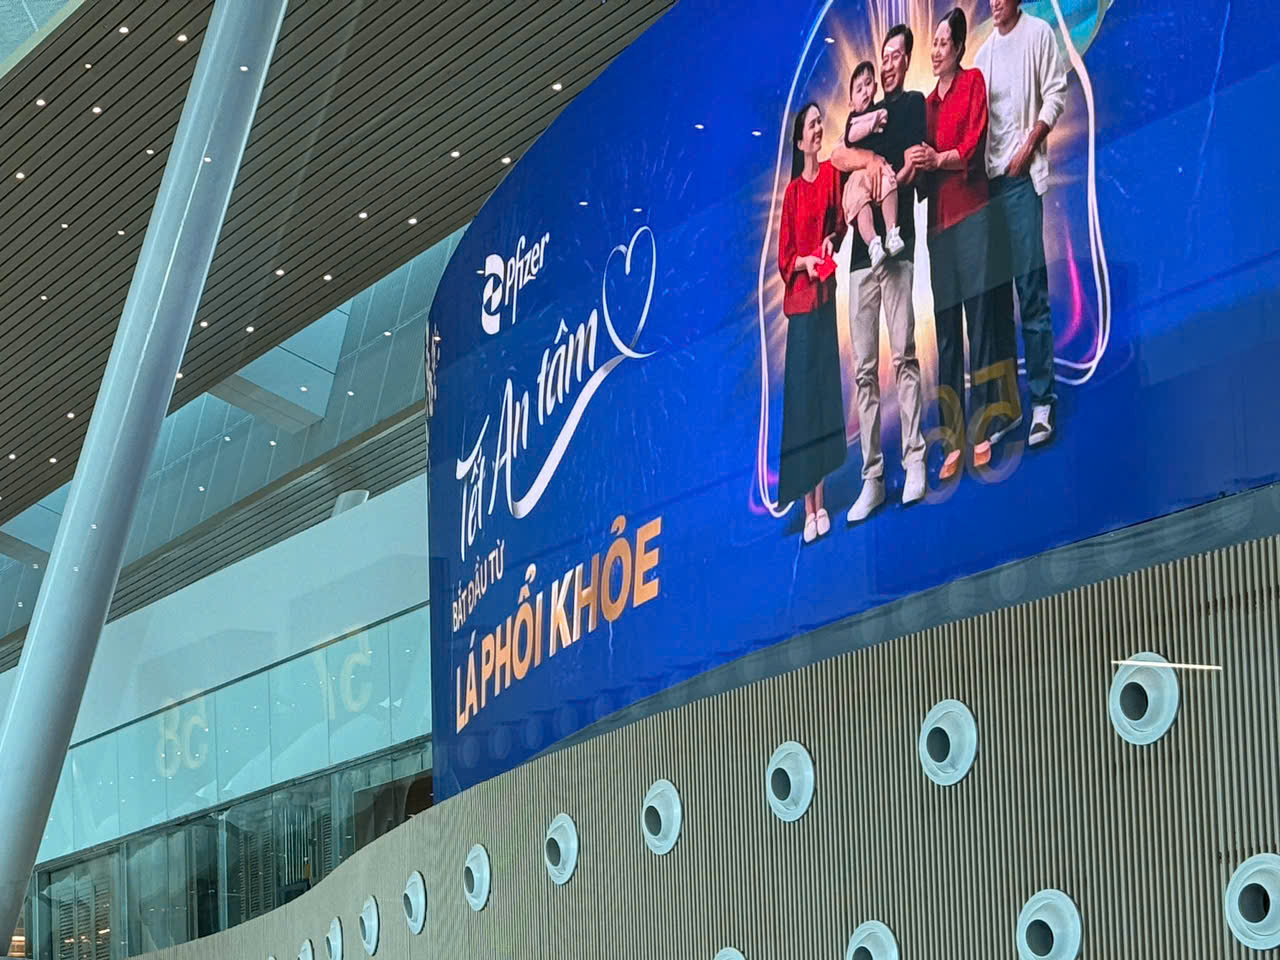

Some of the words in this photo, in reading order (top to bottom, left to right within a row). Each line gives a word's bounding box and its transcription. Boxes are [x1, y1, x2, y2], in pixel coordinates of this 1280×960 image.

[456, 415, 490, 562] Tết
[488, 378, 530, 517] An
[536, 308, 598, 426] tâm
[455, 630, 479, 734] LÁ
[480, 563, 544, 709] PHỔI
[548, 514, 662, 658] KHỎE
[468, 555, 488, 615] ĐẦU
[488, 538, 505, 585] TỪ
